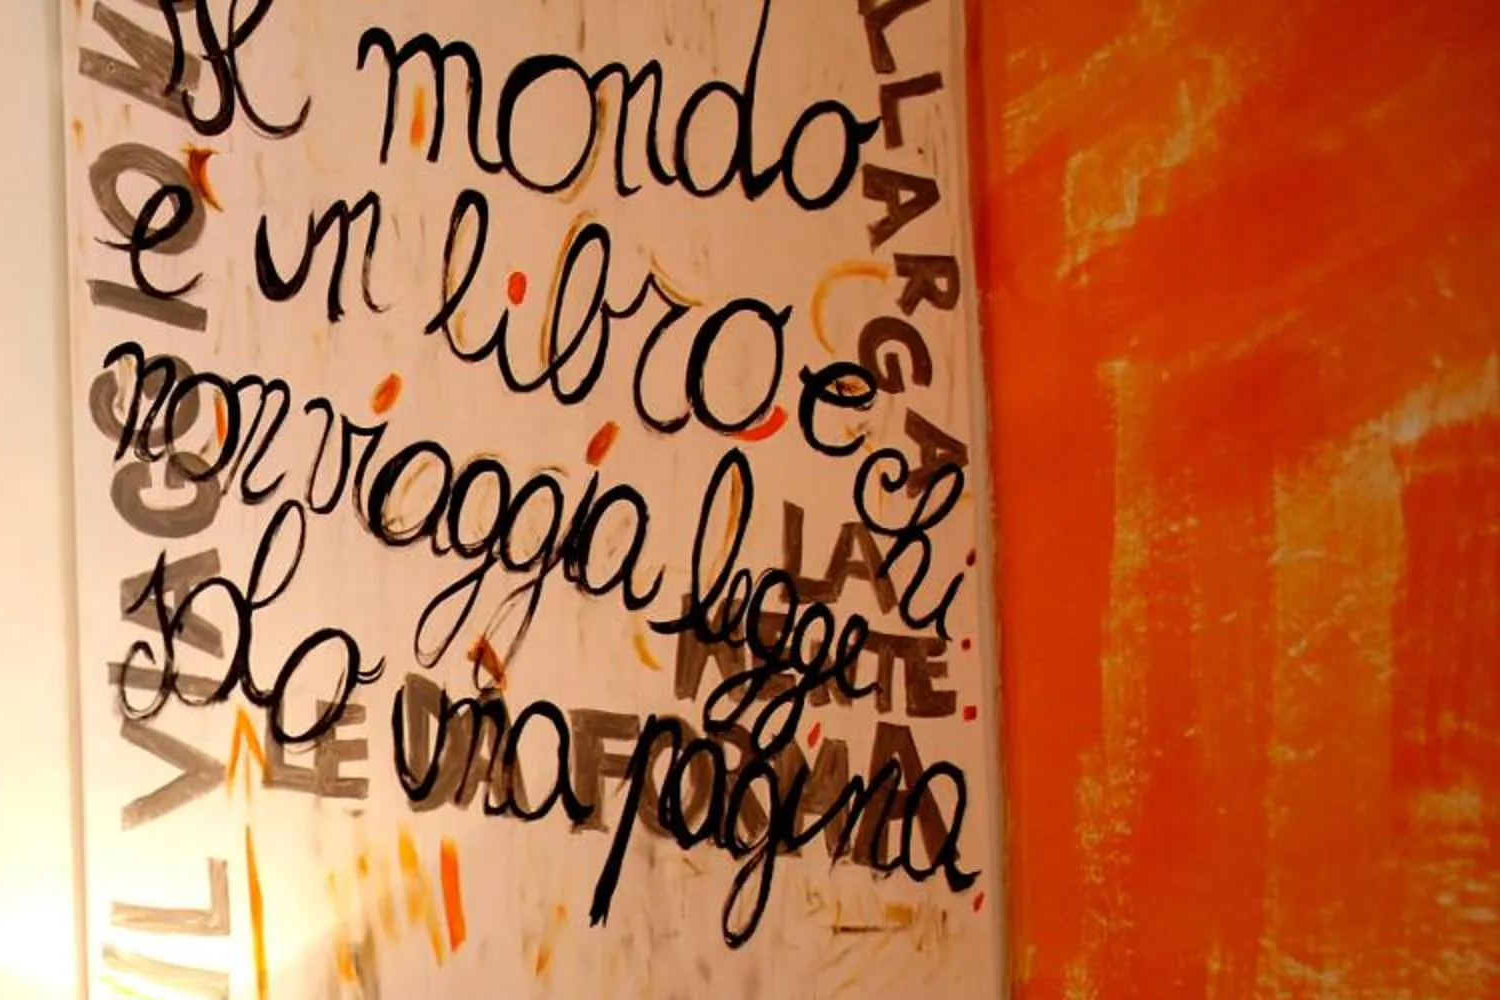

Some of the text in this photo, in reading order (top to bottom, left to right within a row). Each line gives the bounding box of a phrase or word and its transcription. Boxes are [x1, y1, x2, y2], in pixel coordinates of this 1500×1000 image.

[356, 0, 882, 212] mondo
[857, 0, 968, 498] LLARGA
[103, 341, 882, 758] non viaggia legge
[255, 190, 392, 324] un
[798, 362, 878, 457] e
[853, 446, 978, 642] chi
[779, 499, 898, 615] LA
[392, 682, 594, 824] una
